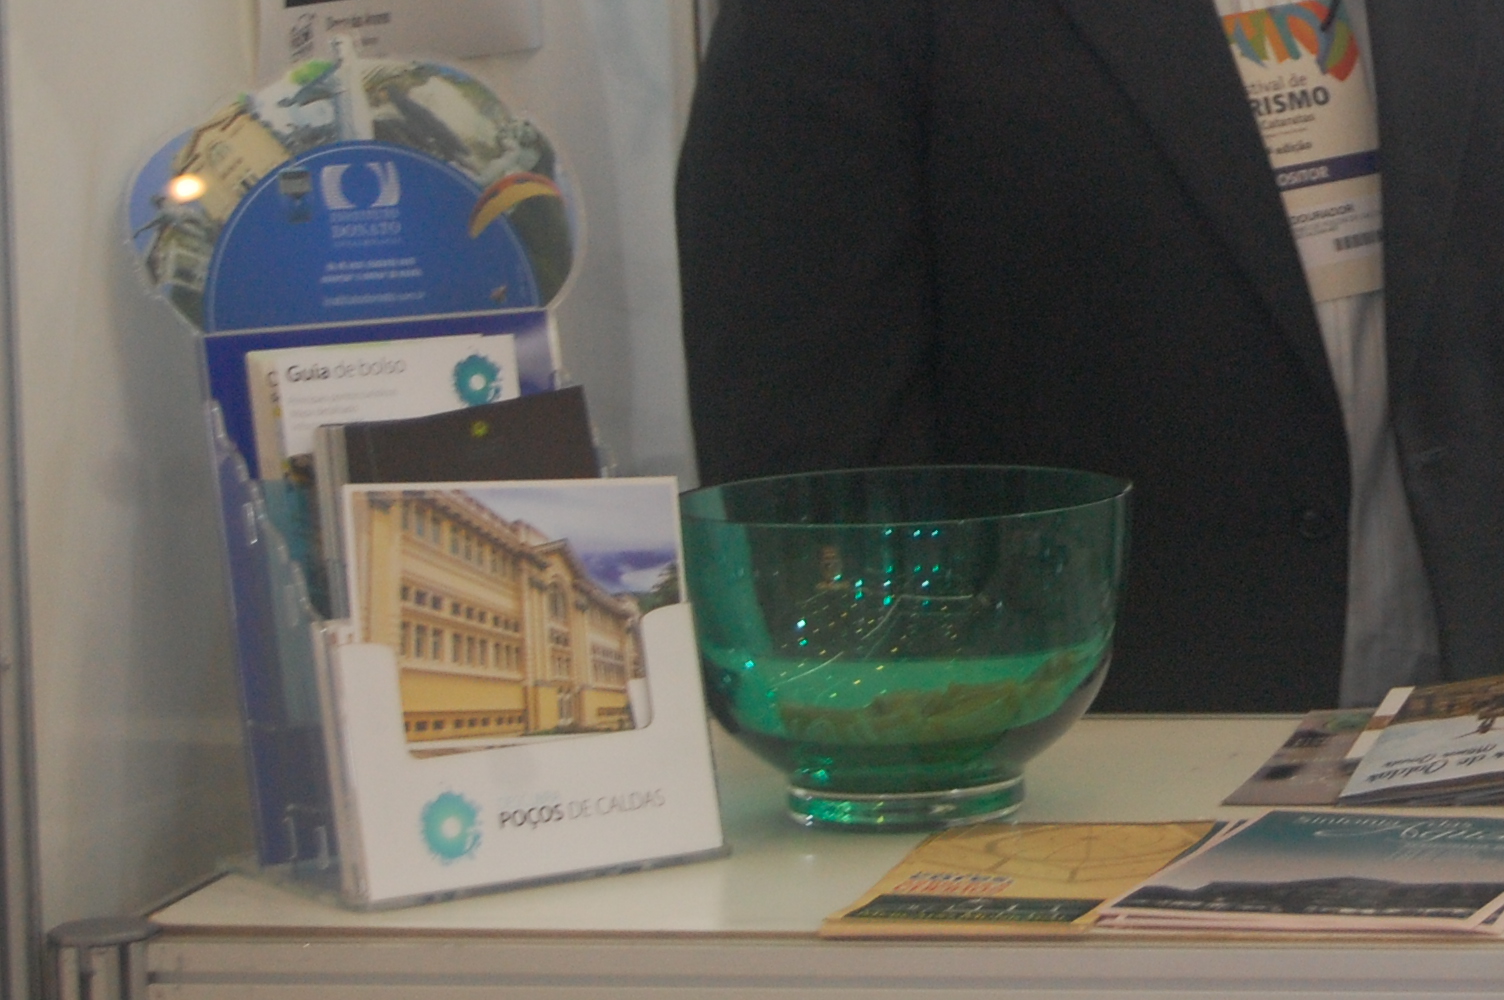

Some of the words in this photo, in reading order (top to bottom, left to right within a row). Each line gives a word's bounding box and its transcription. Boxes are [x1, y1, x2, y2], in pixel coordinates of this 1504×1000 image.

[1250, 86, 1331, 116] RISMO
[286, 363, 330, 383] Guia
[334, 359, 355, 379] de
[359, 357, 407, 378] bolso
[498, 803, 565, 830] POÇOS
[568, 799, 592, 821] DE
[595, 788, 666, 817] CALDAS
